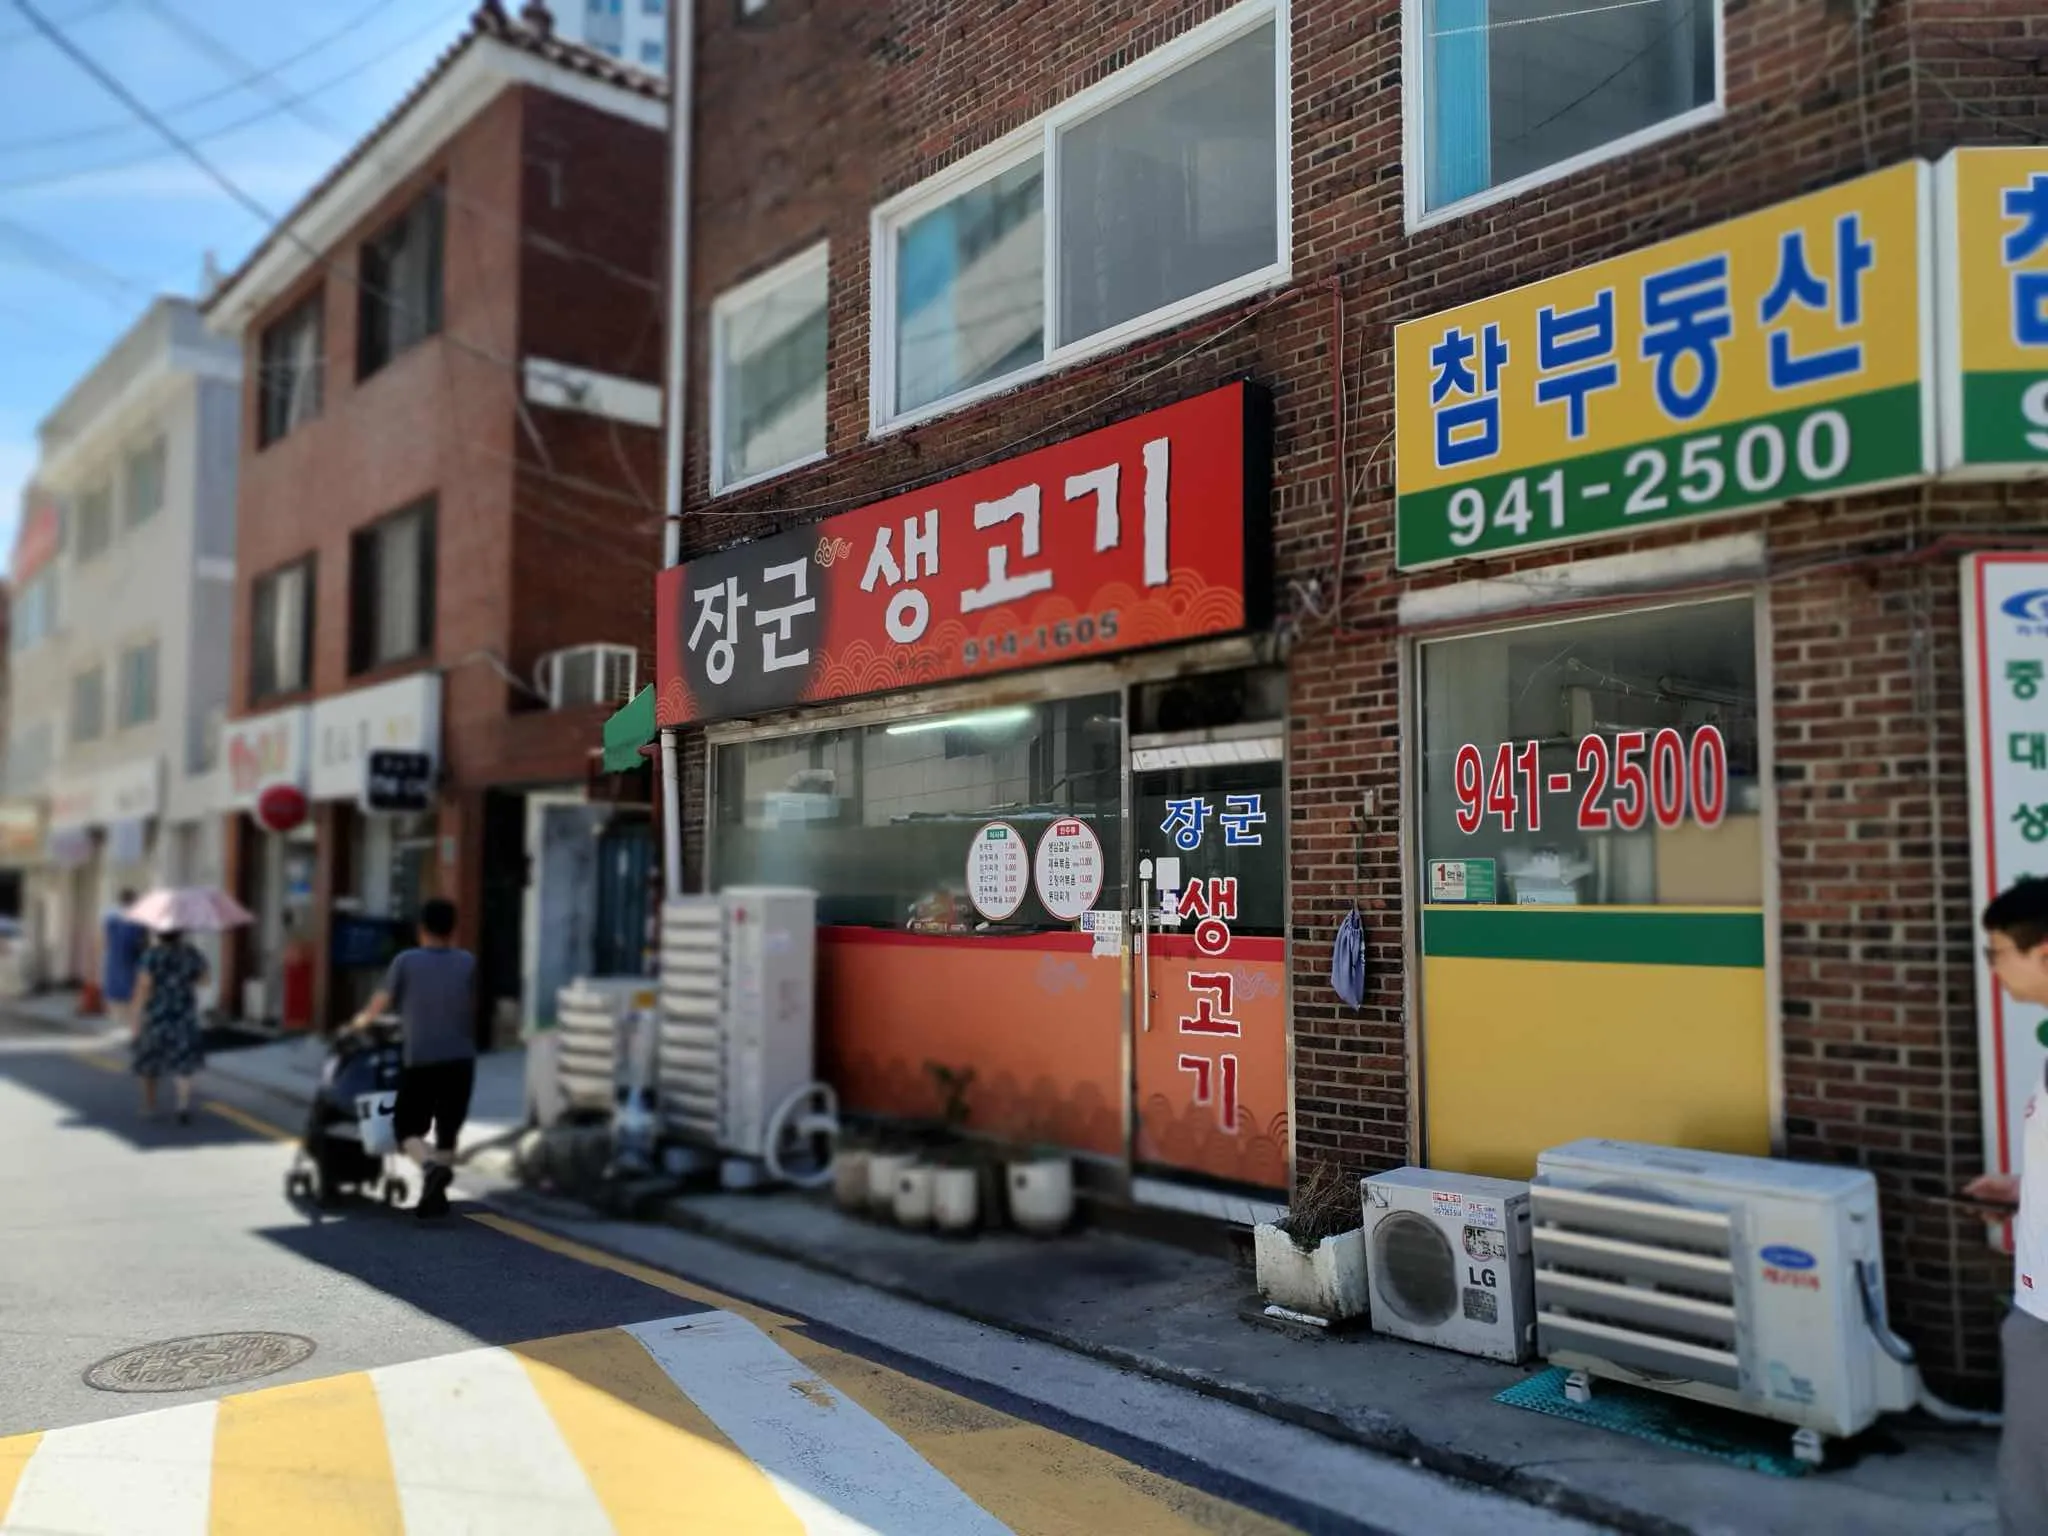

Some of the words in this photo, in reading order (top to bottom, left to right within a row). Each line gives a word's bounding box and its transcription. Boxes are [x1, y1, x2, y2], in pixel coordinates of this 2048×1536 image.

[1429, 213, 1874, 467] 참부동산
[1448, 411, 1851, 547] 941-2500
[687, 557, 816, 686] 장군
[860, 437, 1170, 644] 생고기
[963, 610, 1119, 666] 914-1605
[1159, 794, 1267, 850] 장군
[1455, 725, 1728, 835] 941-2500
[1178, 877, 1242, 1135] 생고기
[1468, 1265, 1497, 1288] LG
